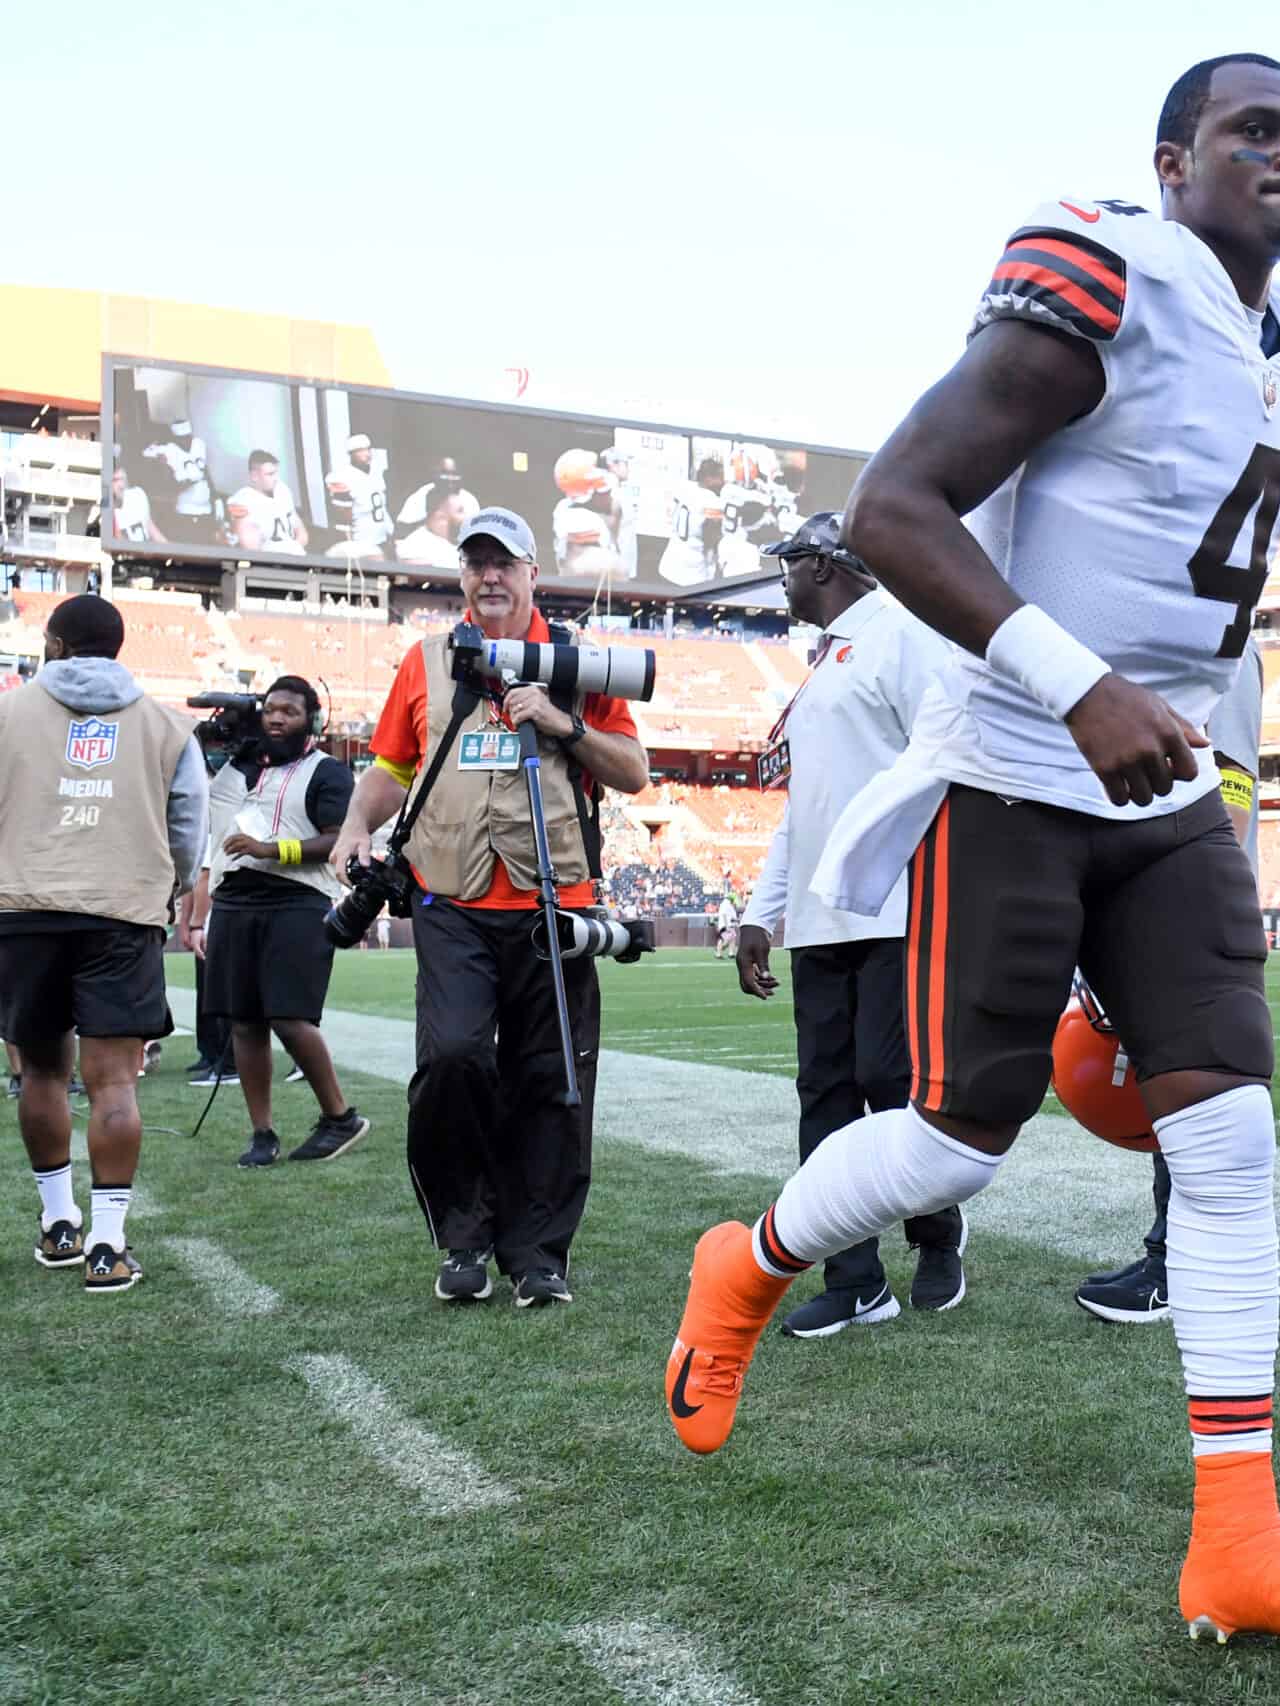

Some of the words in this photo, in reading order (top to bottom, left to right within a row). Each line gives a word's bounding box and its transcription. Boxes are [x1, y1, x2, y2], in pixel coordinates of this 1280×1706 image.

[71, 738, 109, 762] NFL
[59, 777, 113, 798] MEDIA
[60, 805, 100, 826] 240
